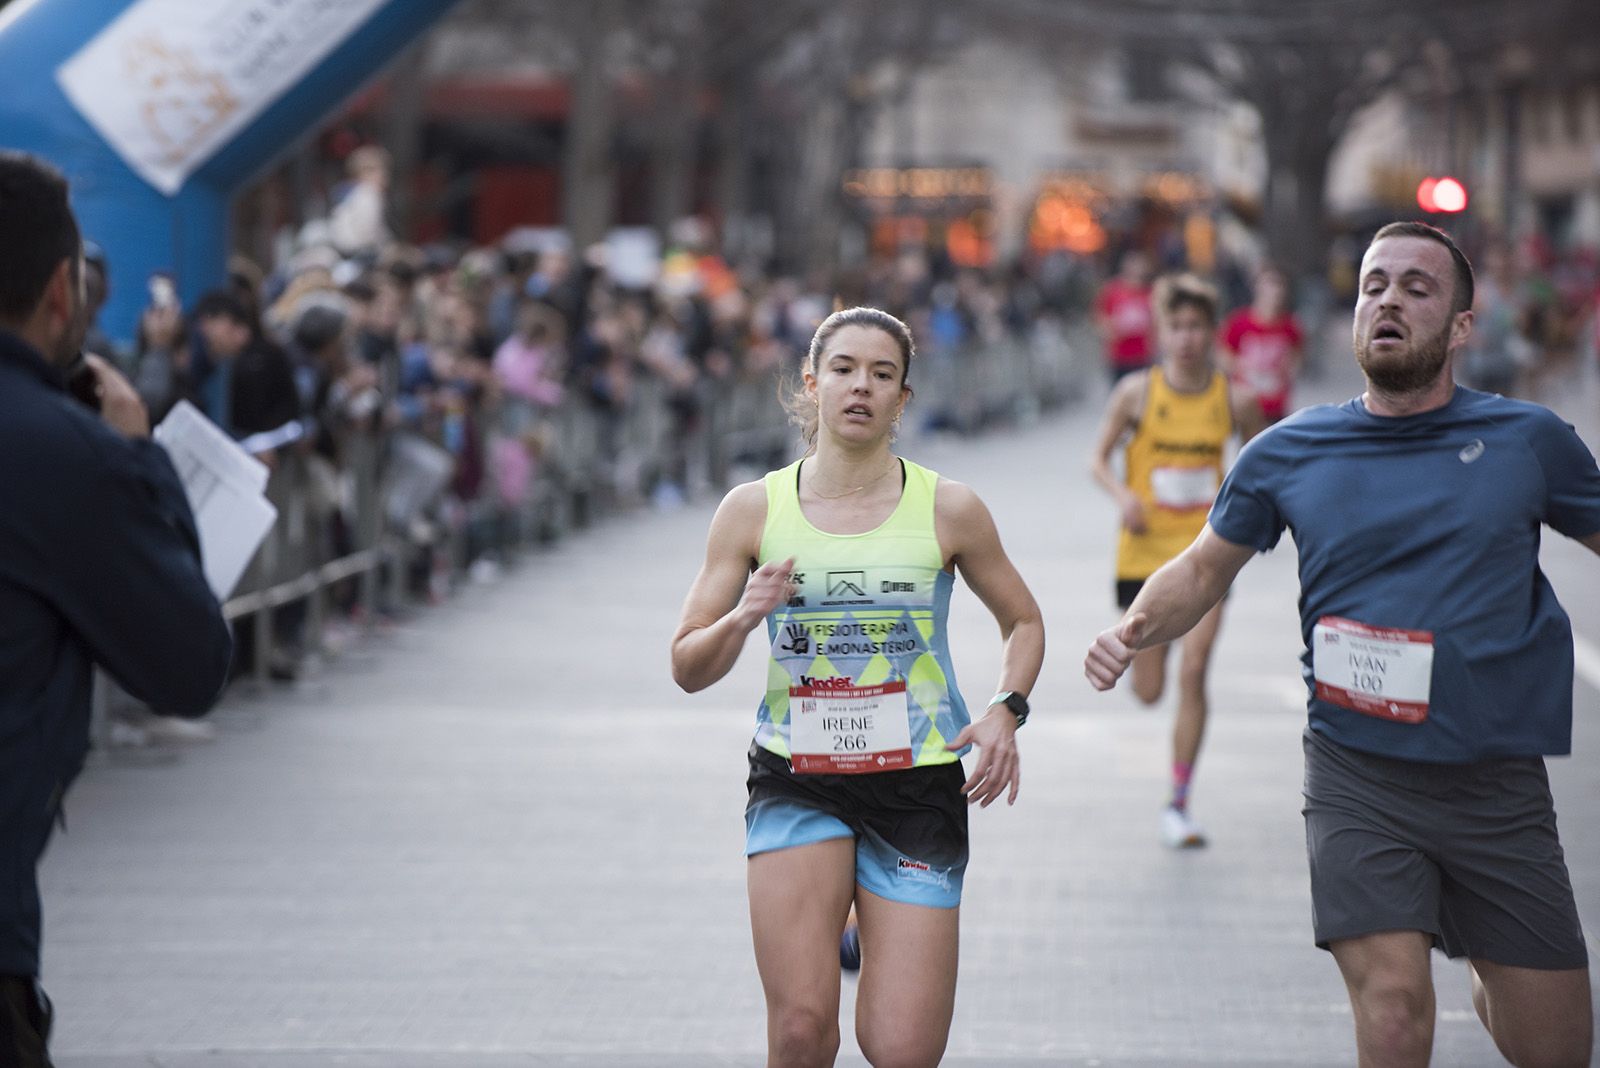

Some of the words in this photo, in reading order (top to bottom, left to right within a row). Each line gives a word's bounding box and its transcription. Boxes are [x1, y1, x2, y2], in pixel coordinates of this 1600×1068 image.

[814, 622, 908, 638] FISIOTERAPIA
[816, 639, 916, 655] E.MONASTERIO
[1352, 671, 1383, 692] 100
[823, 714, 874, 732] IRENE
[833, 735, 867, 751] 266
